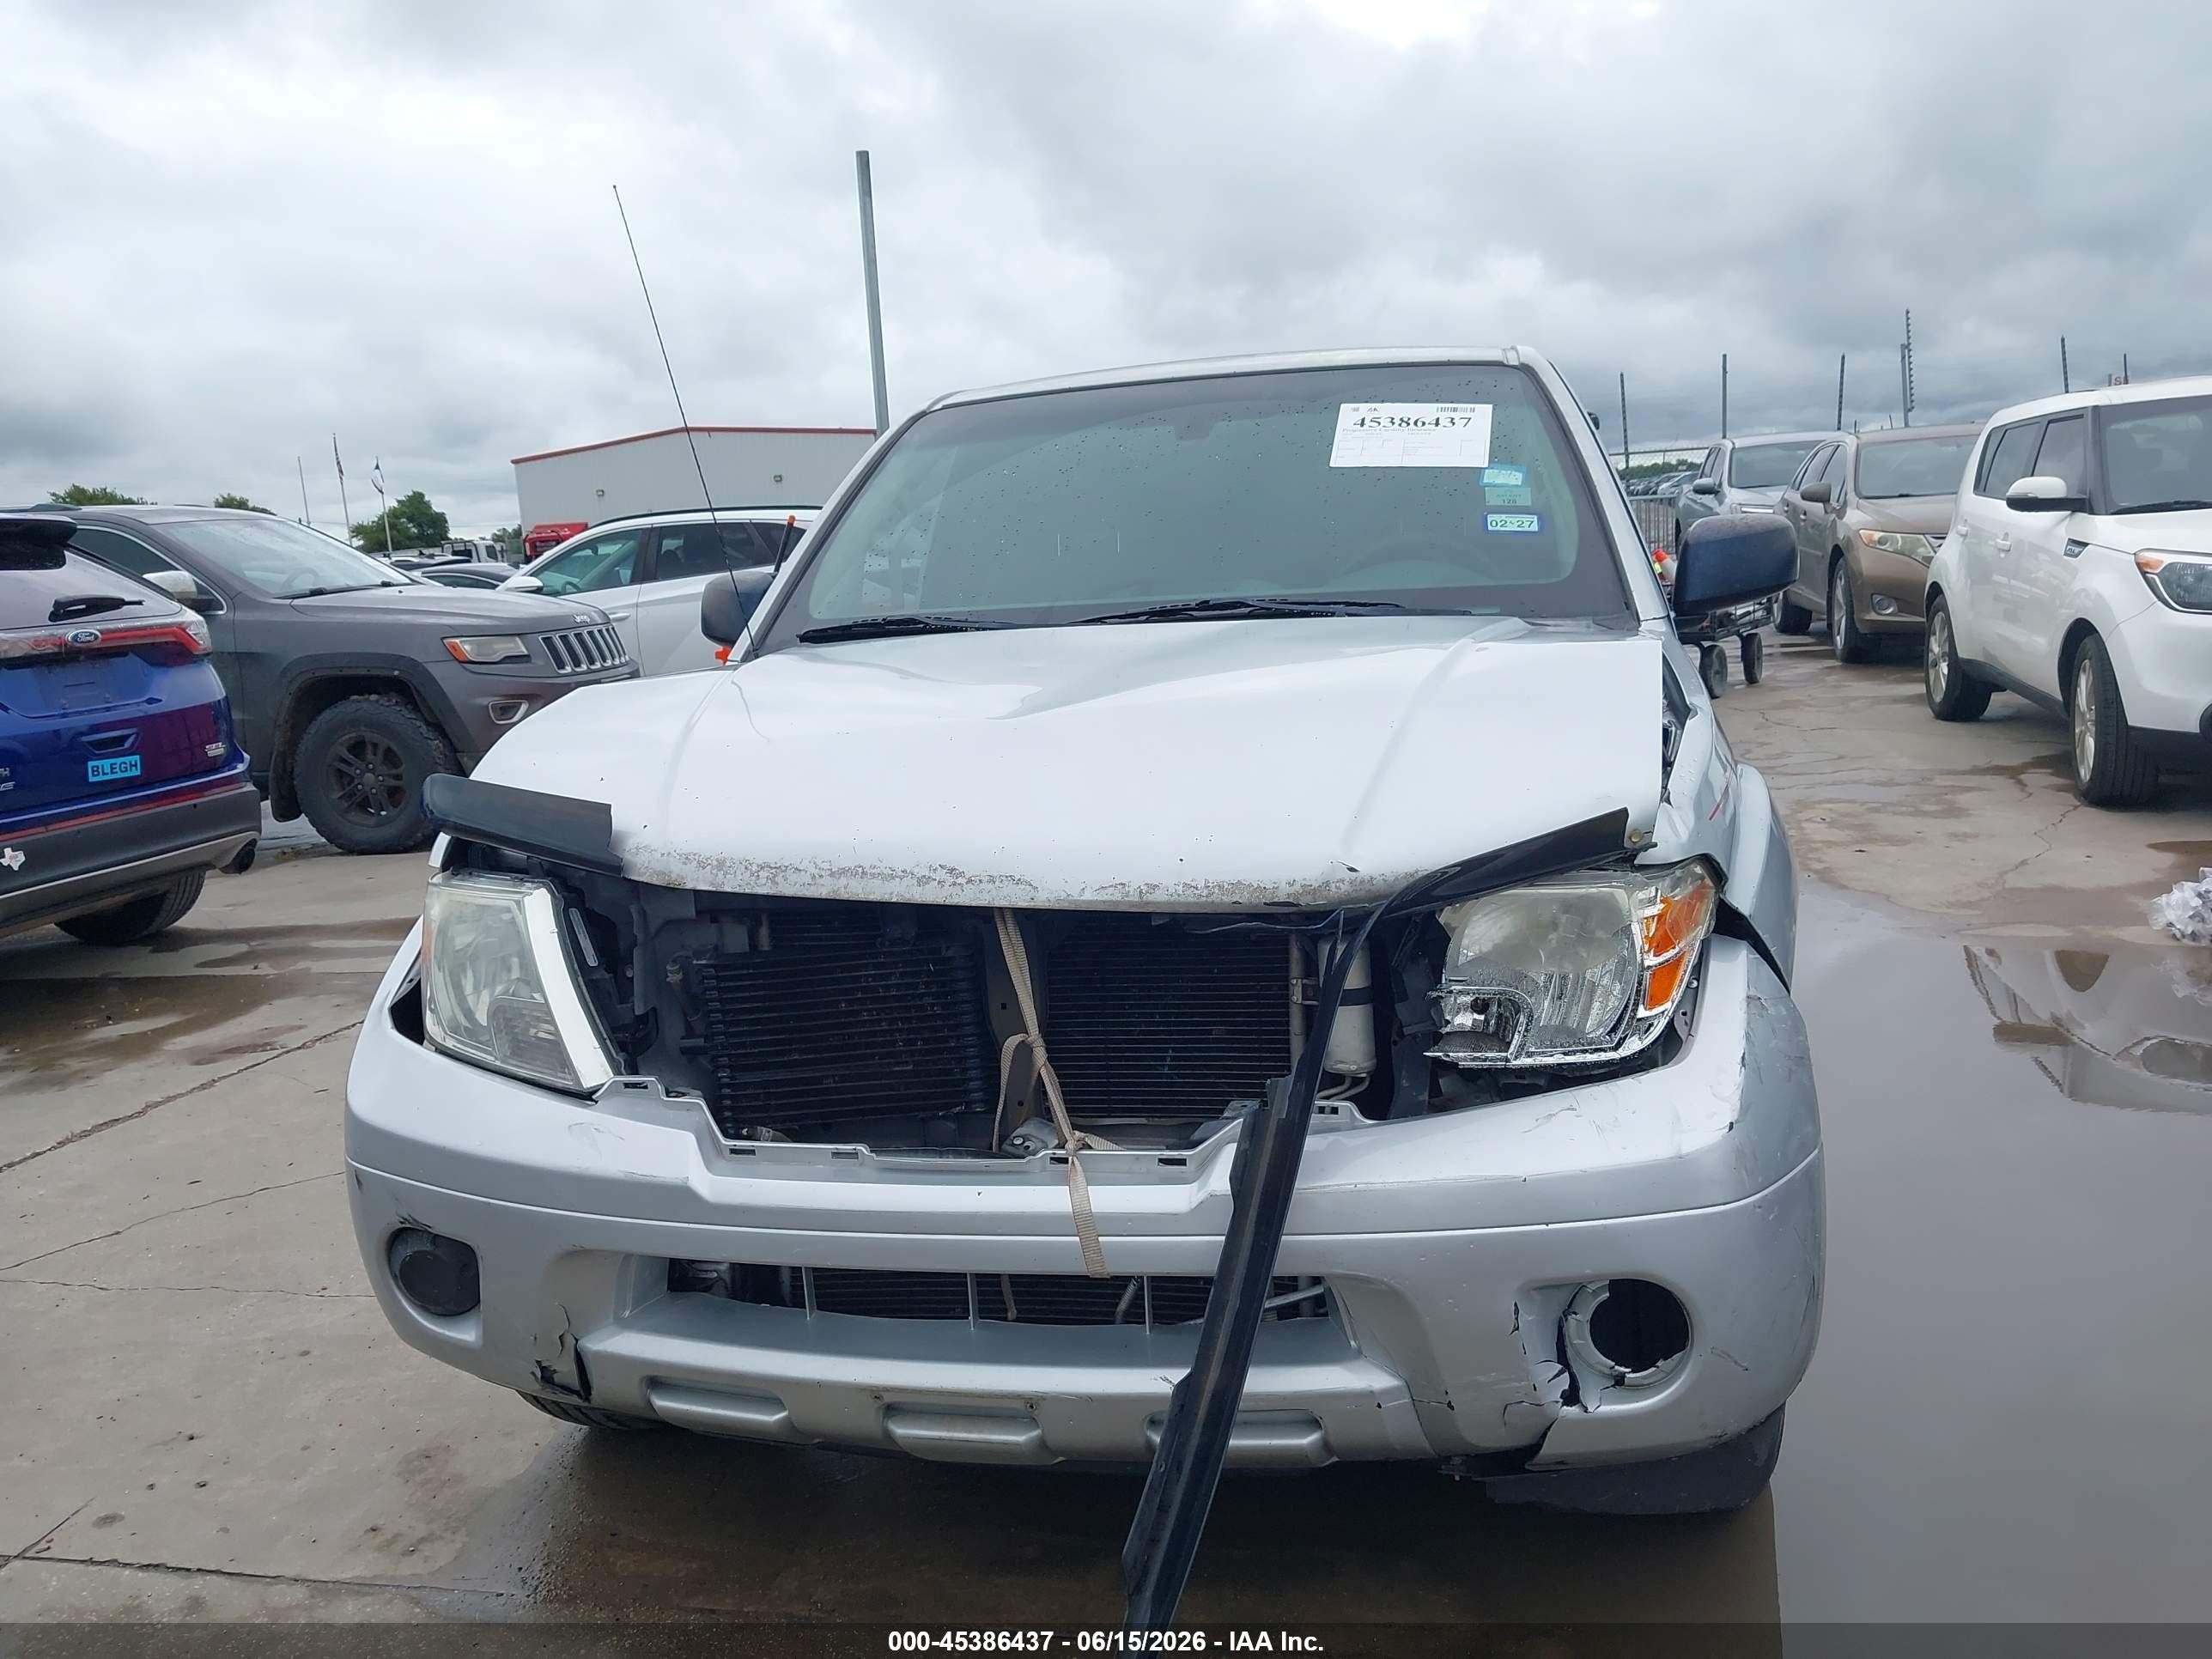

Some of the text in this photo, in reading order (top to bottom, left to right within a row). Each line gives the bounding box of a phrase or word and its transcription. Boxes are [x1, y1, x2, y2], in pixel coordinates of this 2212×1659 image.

[1353, 416, 1472, 428] 45386437
[77, 632, 95, 642] Ford
[91, 760, 138, 777] BLEGH
